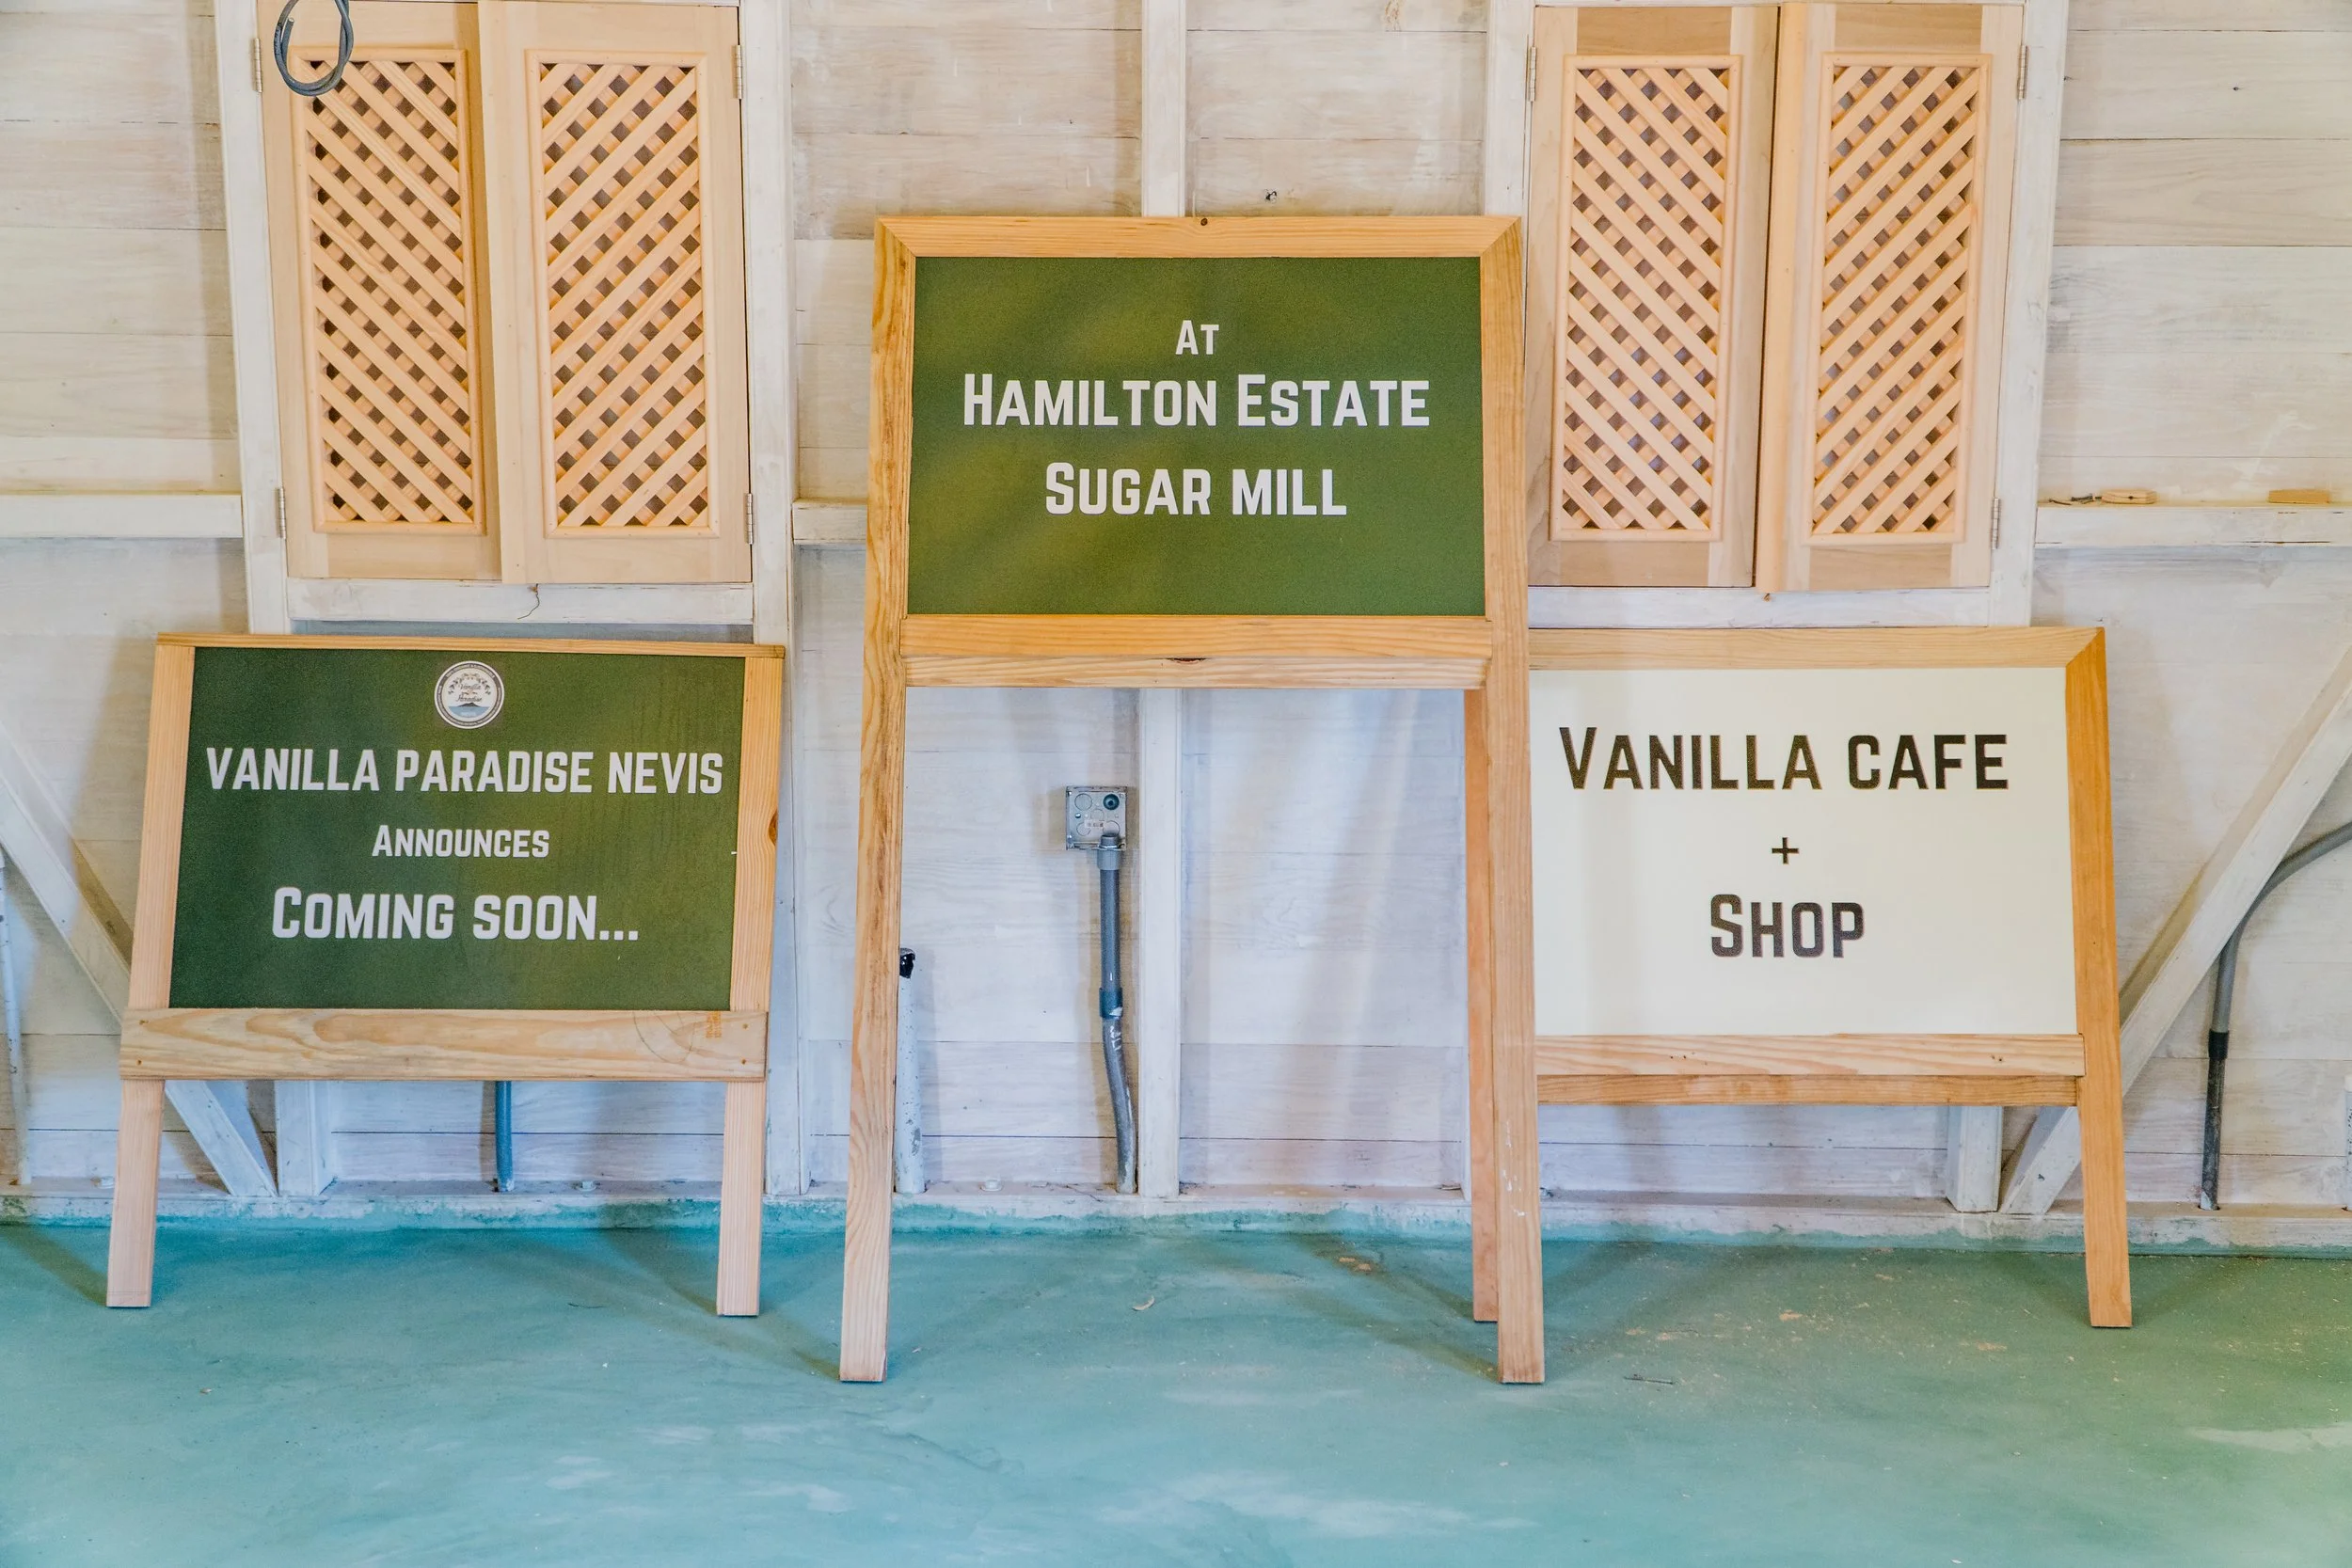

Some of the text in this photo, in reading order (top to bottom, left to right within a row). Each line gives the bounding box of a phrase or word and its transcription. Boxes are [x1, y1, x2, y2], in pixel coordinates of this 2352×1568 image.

[1175, 320, 1219, 356] AT
[963, 373, 1430, 426] HAMILTON ESTATE
[1045, 462, 1347, 515] SUGAR MILL
[206, 747, 723, 794] VANILLA PARADISE NEVIS
[1559, 726, 2008, 790] VANILLA CAFE
[372, 824, 549, 858] ANNOUNCES
[272, 887, 639, 941] COMING SOON...
[1710, 894, 1864, 958] SHOP
